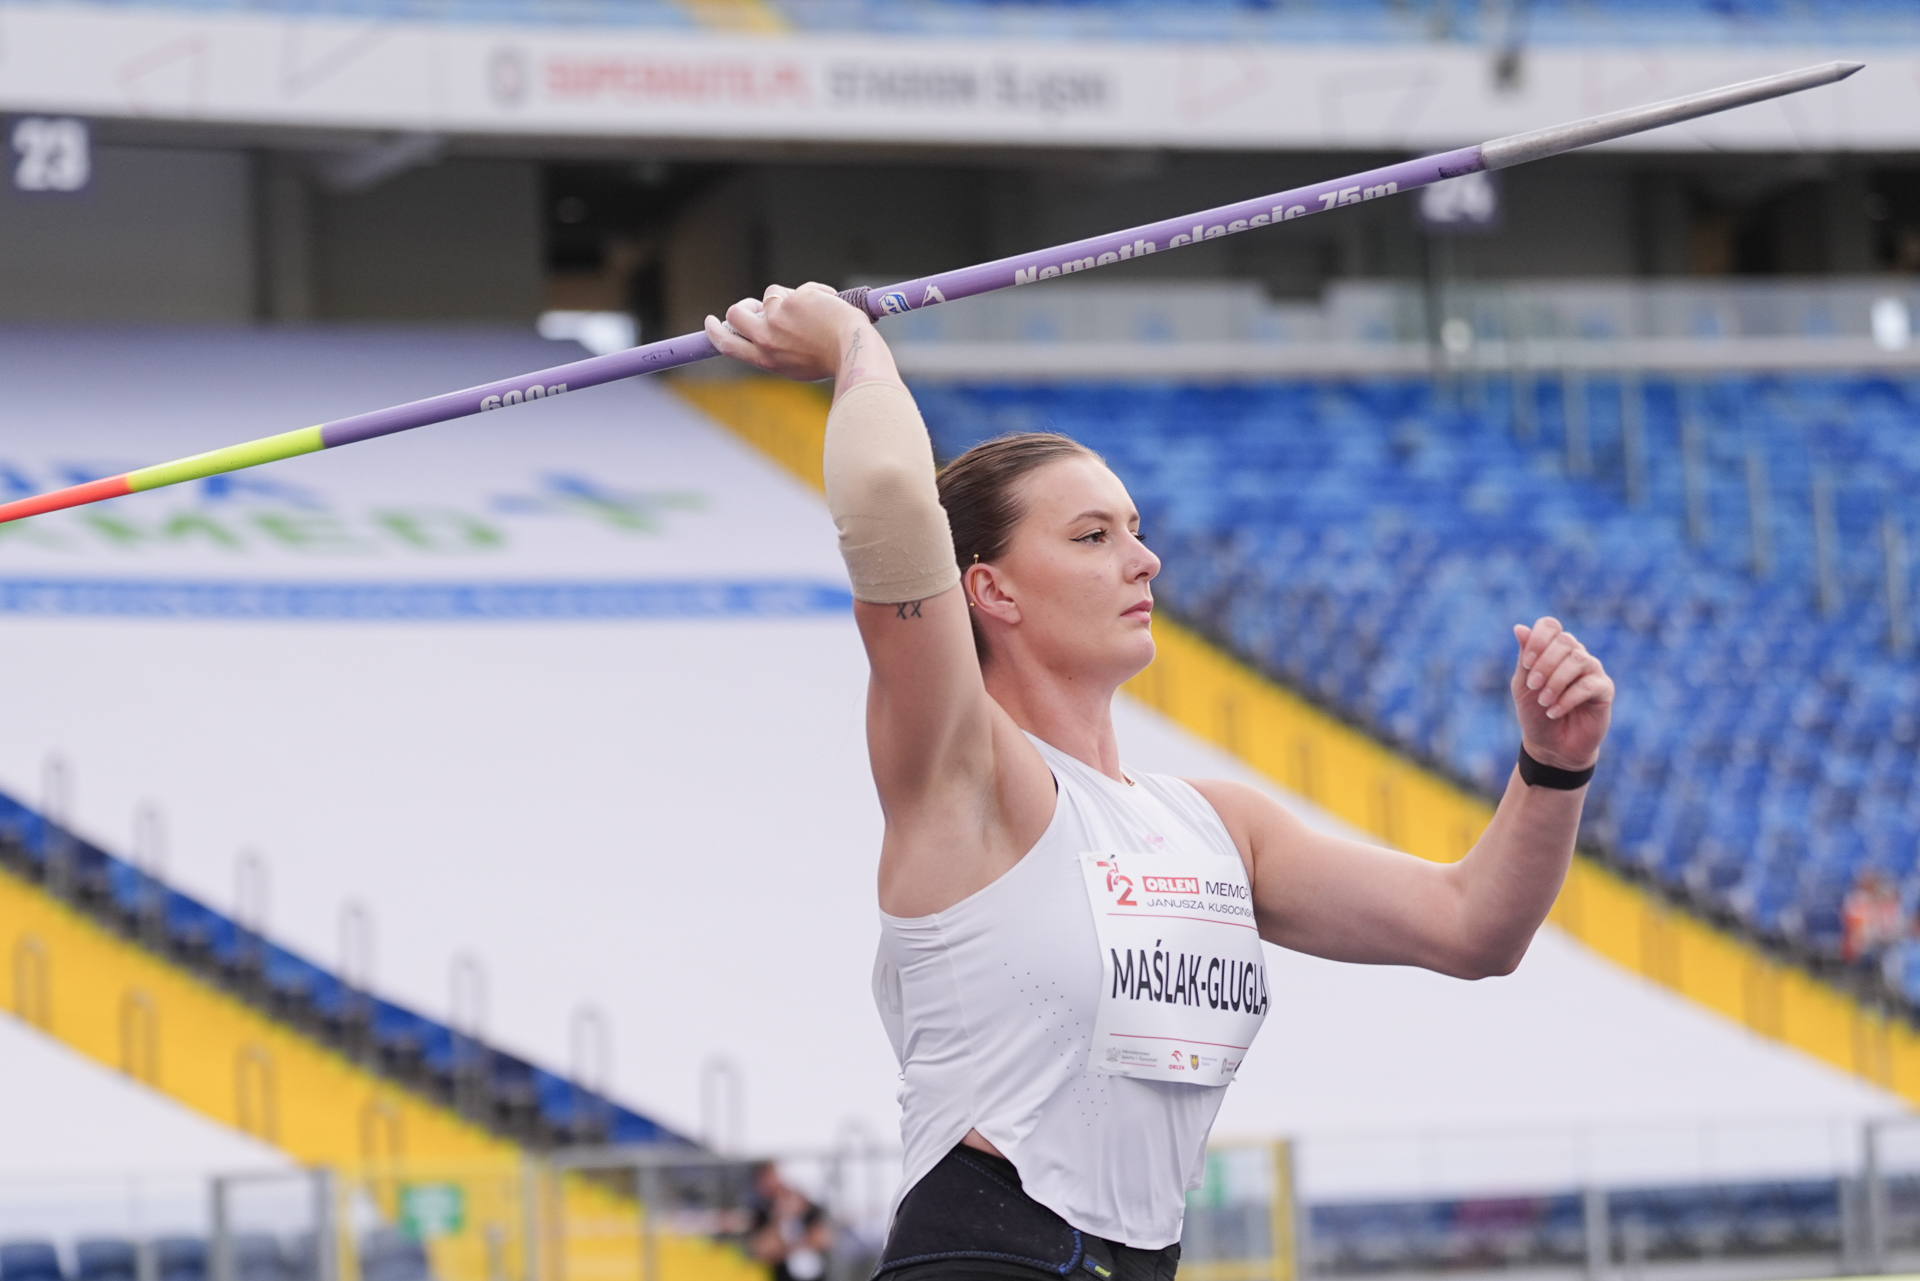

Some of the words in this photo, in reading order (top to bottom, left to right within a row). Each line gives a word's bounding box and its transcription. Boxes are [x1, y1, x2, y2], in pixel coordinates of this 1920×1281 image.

[13, 119, 89, 191] 23
[1420, 174, 1495, 223] 24
[1015, 239, 1157, 286] Nemeth
[1169, 205, 1306, 248] classic
[1318, 181, 1399, 211] 75m
[1144, 877, 1198, 893] ORLEN
[1147, 898, 1205, 911] JANUSZA
[1110, 939, 1268, 1016] MAŚLAK-GLUGLA
